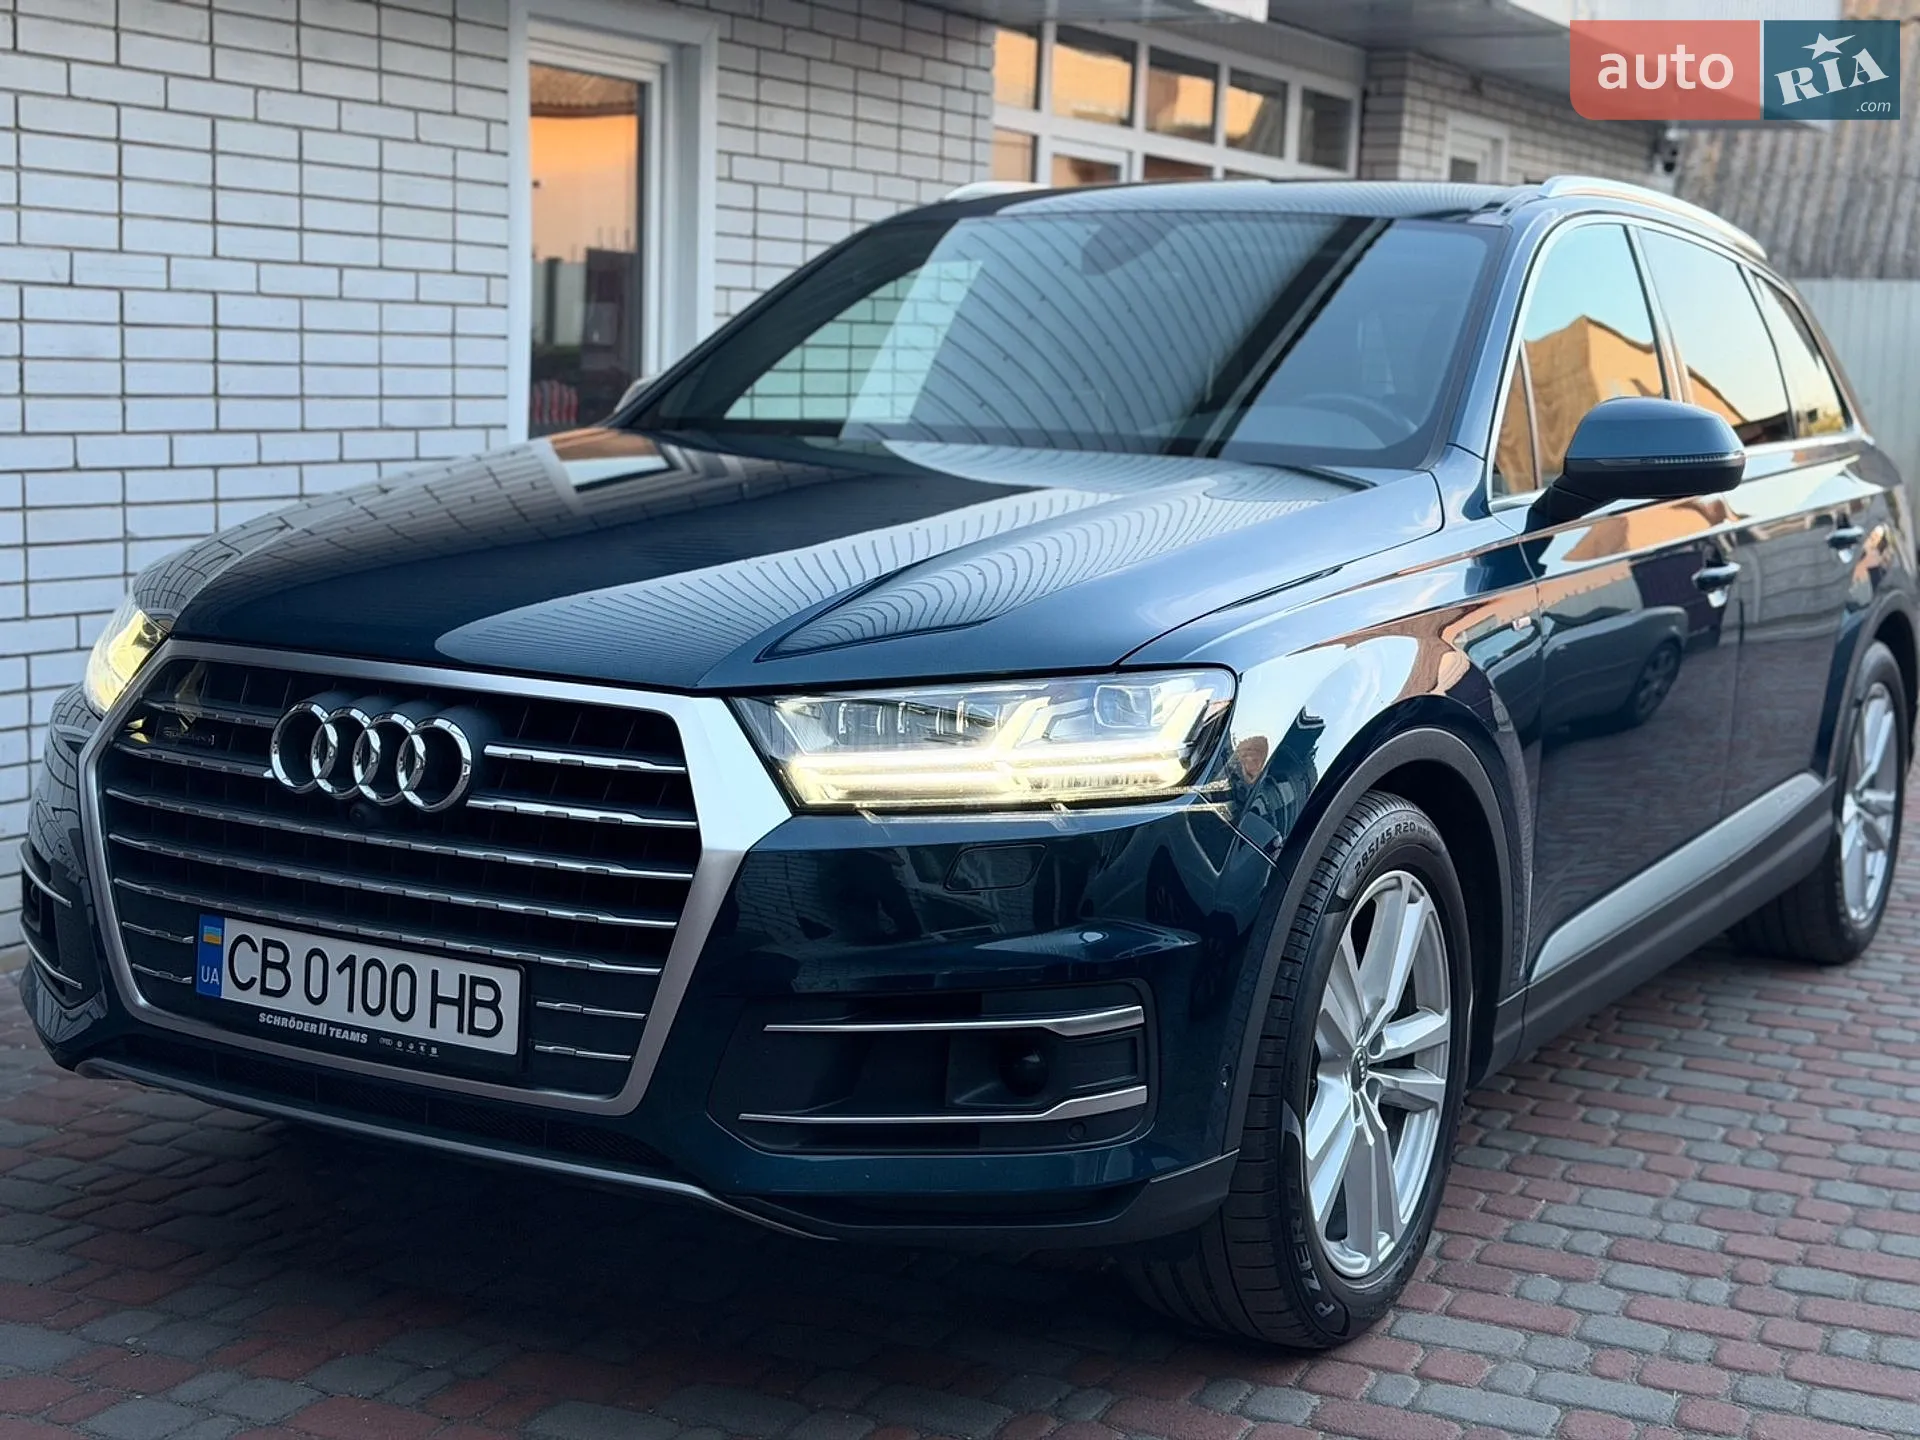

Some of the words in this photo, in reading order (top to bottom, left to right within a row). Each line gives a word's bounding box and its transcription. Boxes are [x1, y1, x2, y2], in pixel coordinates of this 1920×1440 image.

[1354, 827, 1392, 877] 285/45
[1394, 821, 1416, 836] R20
[201, 966, 220, 986] UA
[228, 934, 292, 998] CB
[304, 947, 417, 1022] 0100
[430, 968, 504, 1038] HB
[258, 1012, 318, 1034] SCHRÖDER
[329, 1027, 368, 1044] TEAMS
